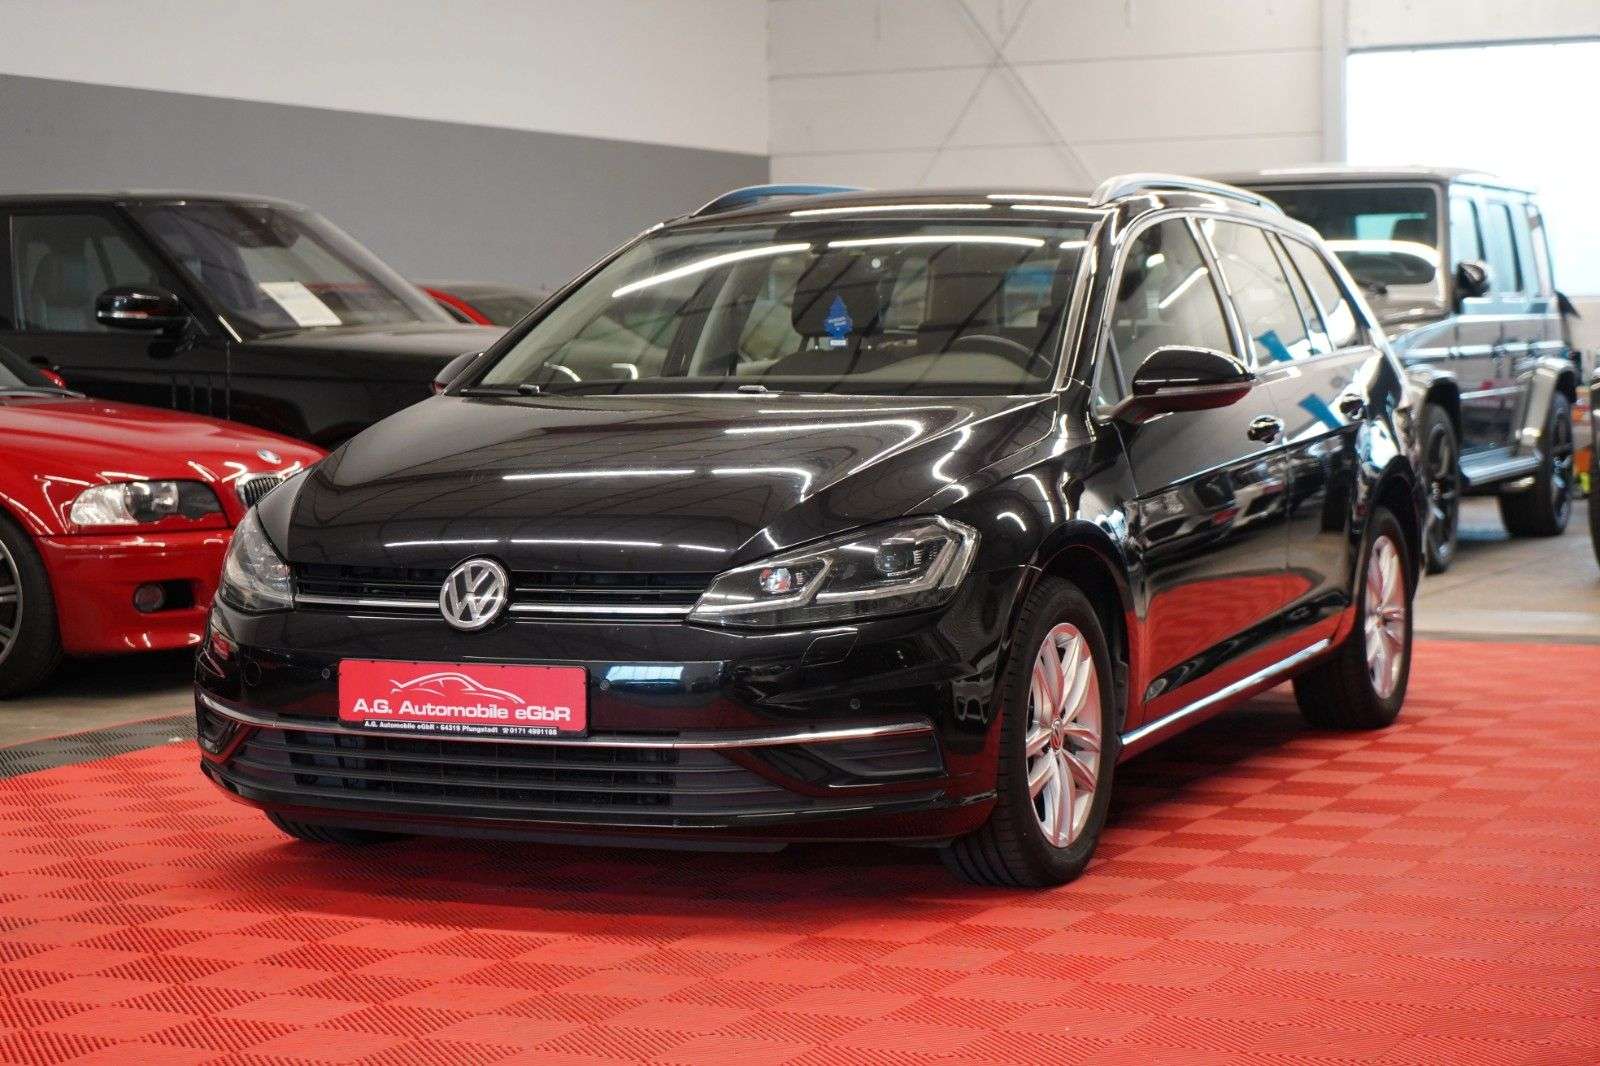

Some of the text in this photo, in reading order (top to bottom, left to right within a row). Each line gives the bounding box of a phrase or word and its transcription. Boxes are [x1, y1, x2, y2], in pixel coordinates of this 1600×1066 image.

[352, 698, 571, 721] A.G. Automobile eGbR
[379, 721, 415, 729] Automobile
[416, 723, 435, 731] eGbR
[461, 725, 499, 734] Pfungstadt
